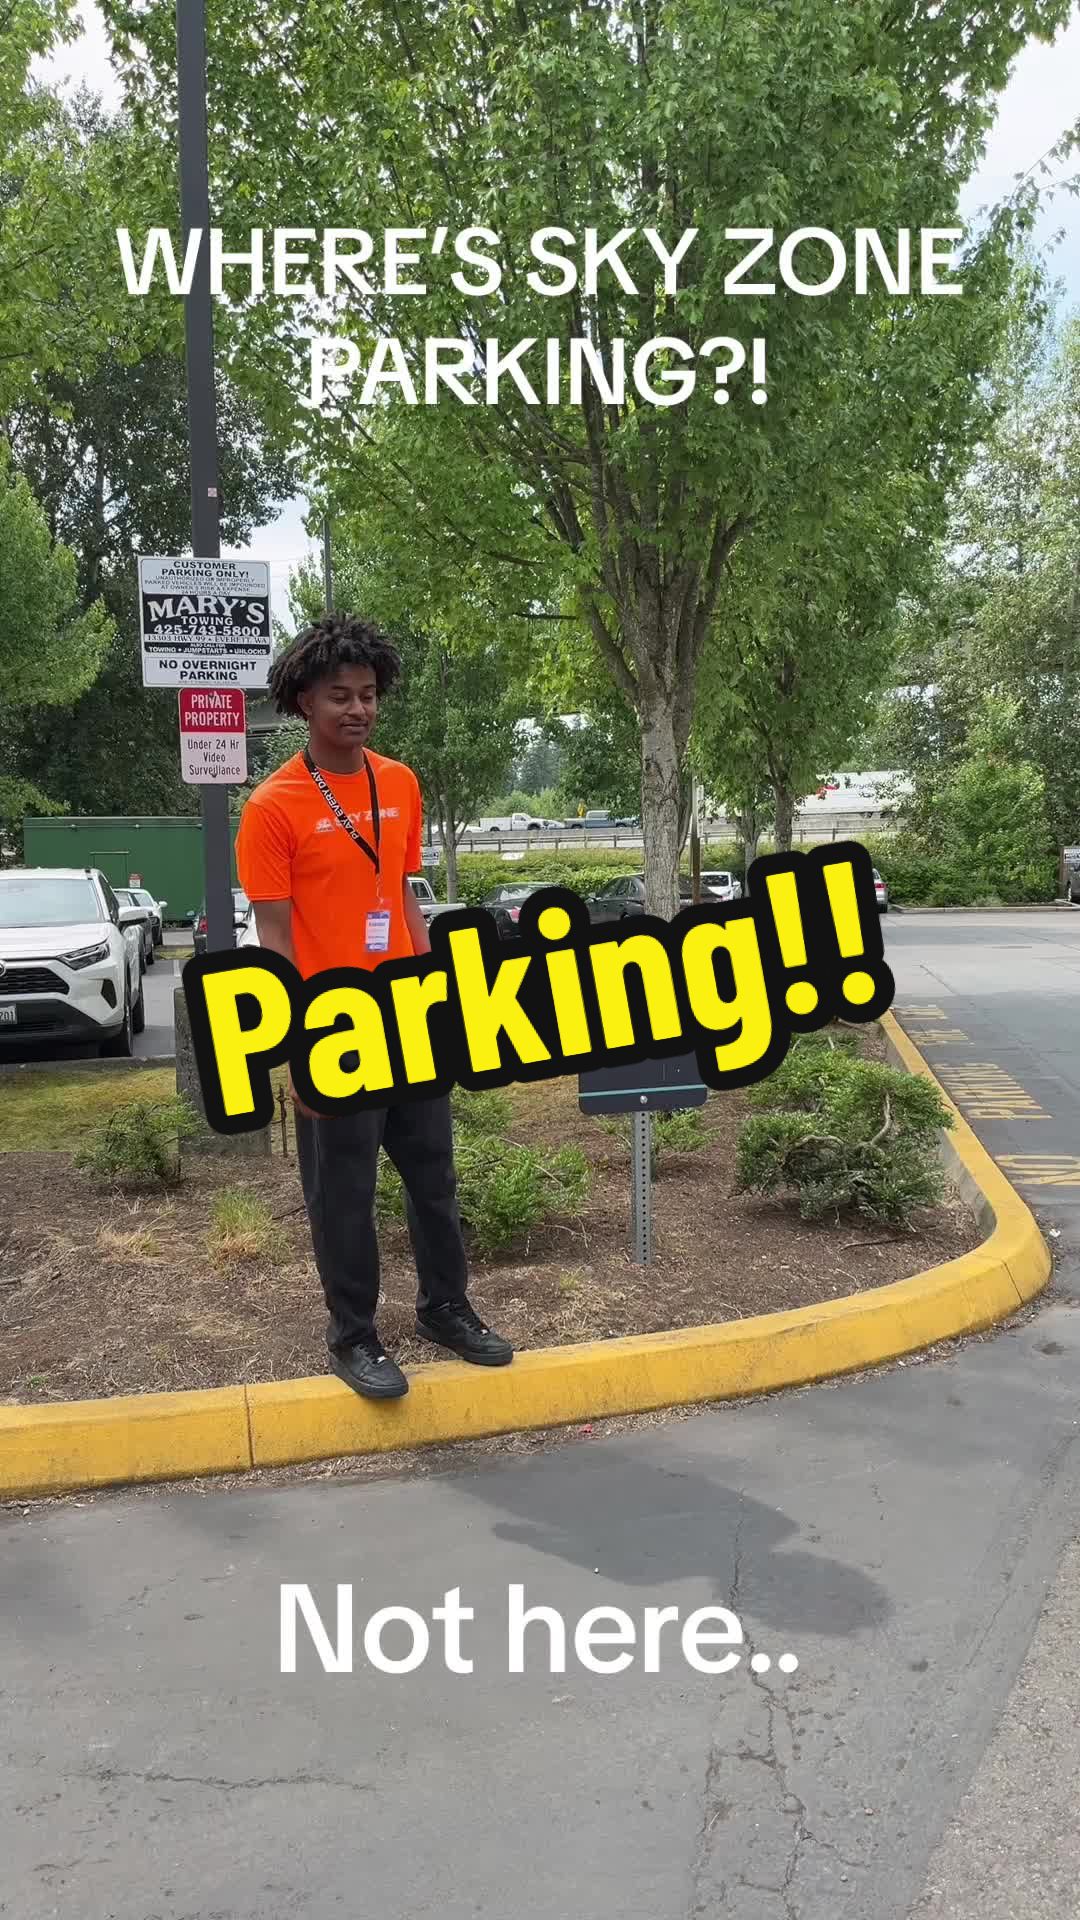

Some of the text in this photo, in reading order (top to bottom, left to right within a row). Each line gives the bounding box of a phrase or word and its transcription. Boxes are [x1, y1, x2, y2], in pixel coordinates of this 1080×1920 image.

[173, 561, 236, 570] CUSTOMER
[161, 568, 249, 578] PARKING ONLY!
[147, 595, 265, 624] MARY'S
[180, 616, 233, 625] TOWING
[153, 624, 261, 636] 425-743-5800
[159, 660, 257, 671] NO OVERNIGHT
[179, 671, 238, 681] PARKING
[191, 693, 233, 709] PRIVATE
[184, 711, 240, 727] PROPERTY
[187, 739, 239, 750] Under 24 Hr
[203, 751, 226, 763] Video
[322, 788, 345, 818] EVERY
